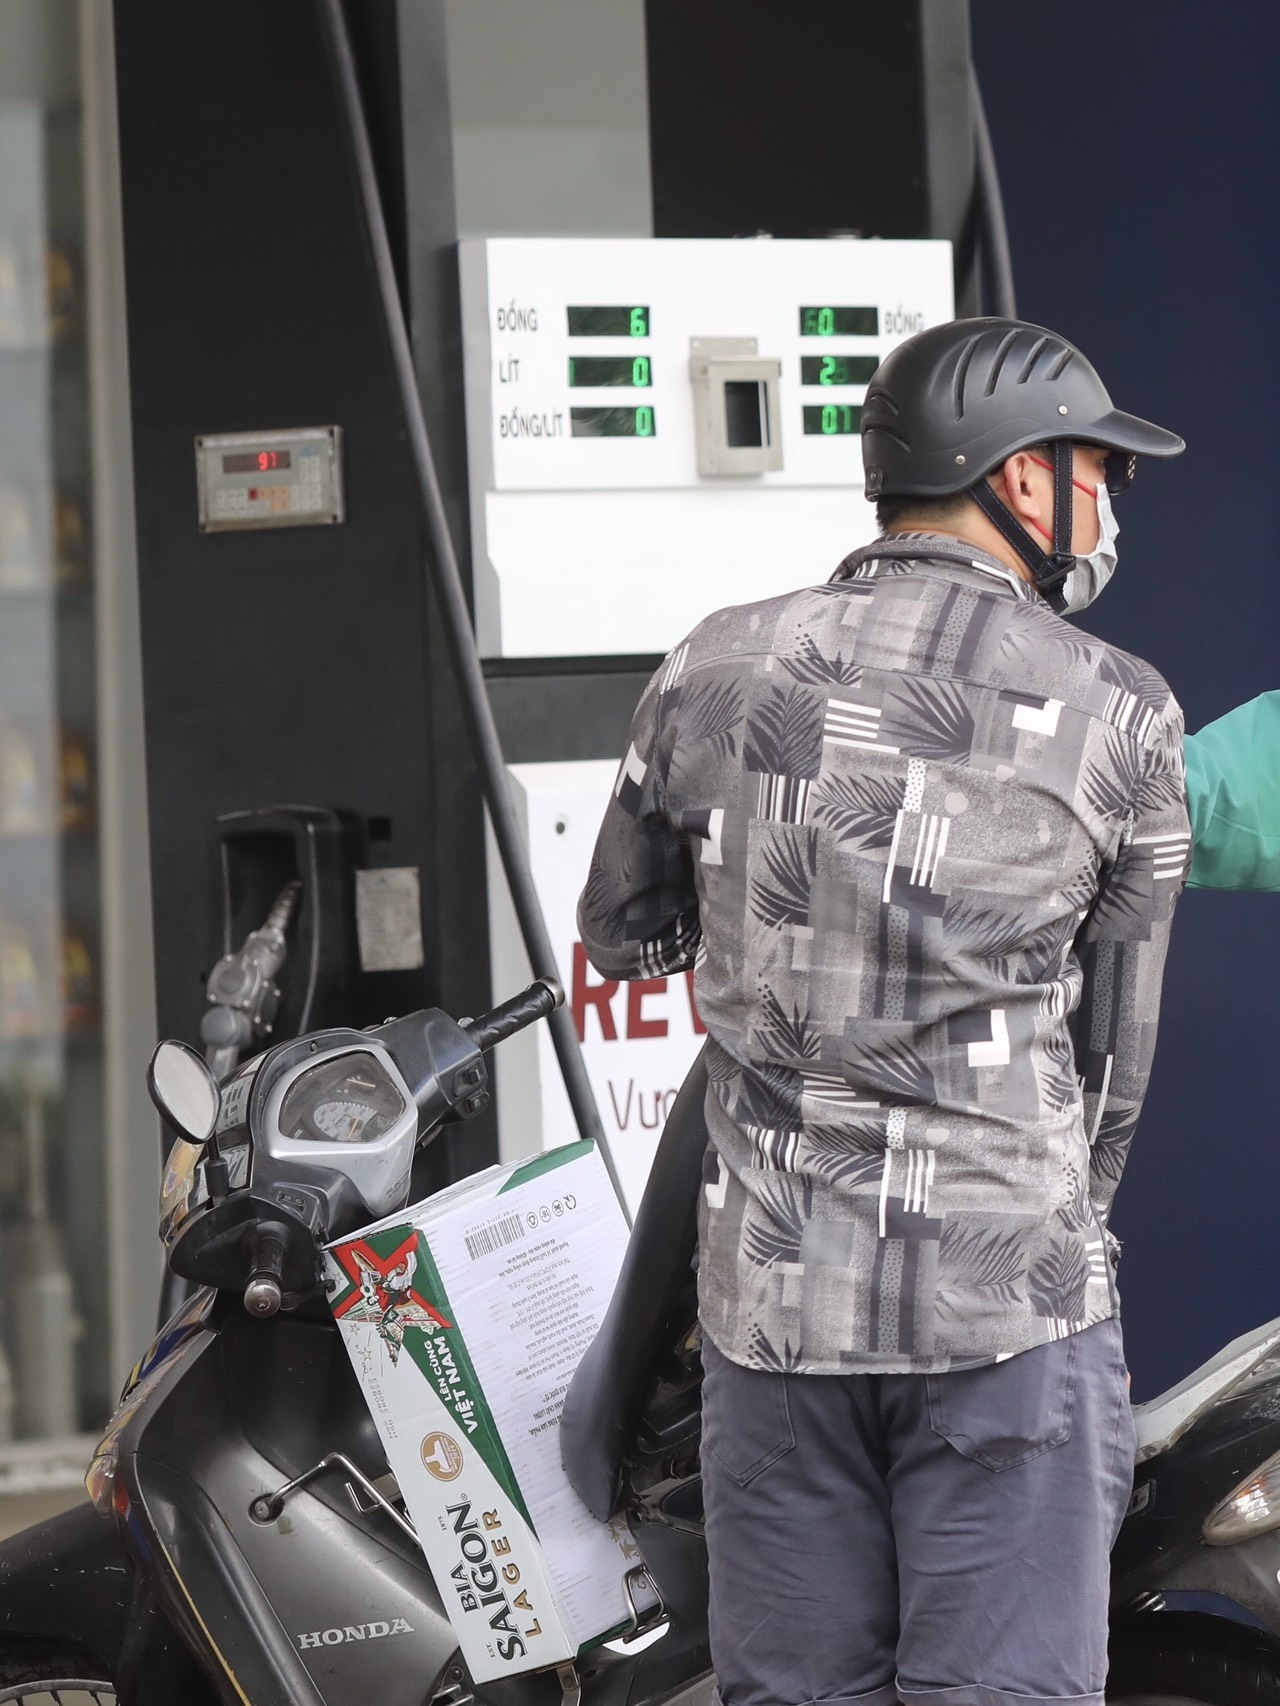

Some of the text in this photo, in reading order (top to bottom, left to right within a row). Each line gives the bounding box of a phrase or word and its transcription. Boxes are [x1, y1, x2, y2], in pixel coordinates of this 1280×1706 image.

[424, 1340, 452, 1401] LÊN CÙNG
[433, 1336, 479, 1434] VIỆT NAM
[445, 1500, 528, 1661] SAIGON
[450, 1560, 480, 1613] BIA
[482, 1508, 542, 1638] LAGER
[297, 1618, 415, 1649] HONDA
